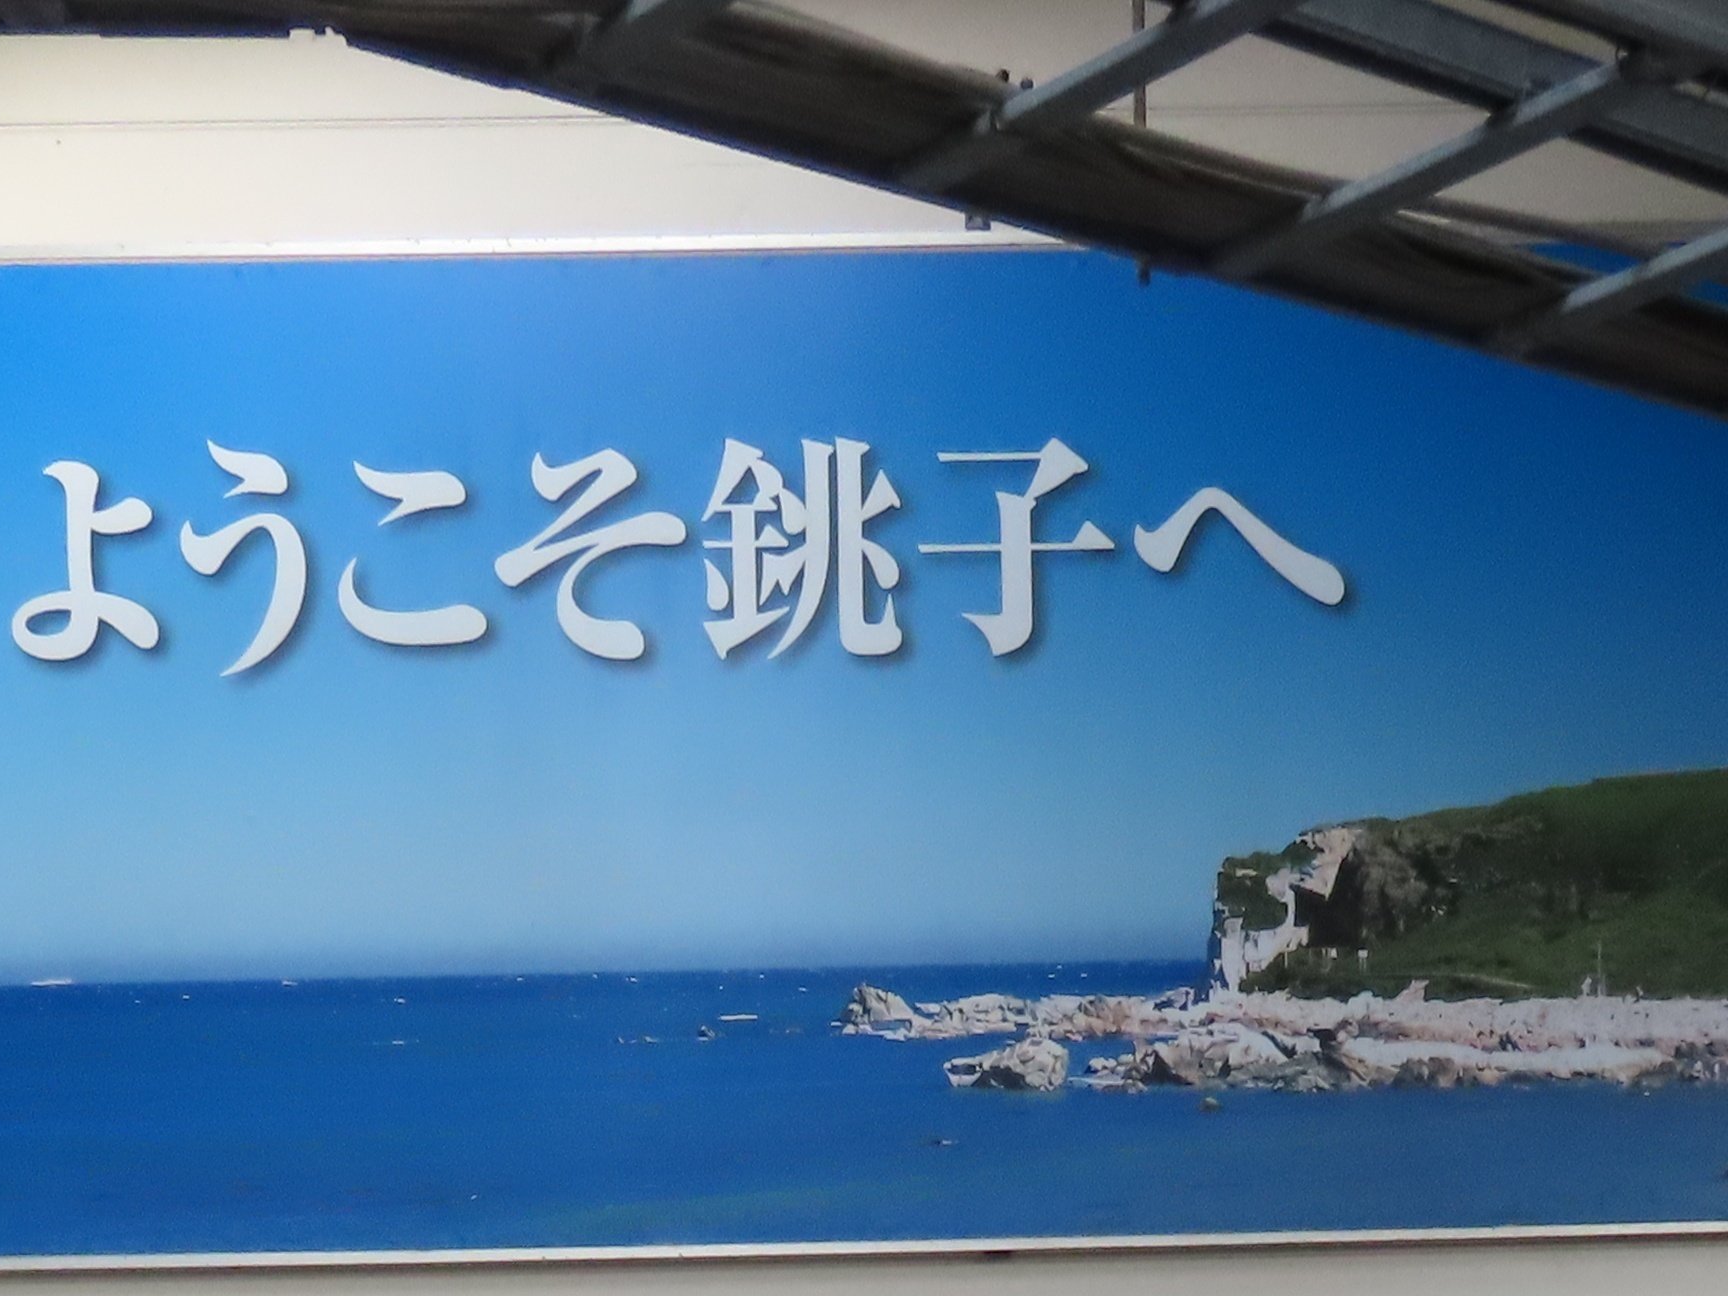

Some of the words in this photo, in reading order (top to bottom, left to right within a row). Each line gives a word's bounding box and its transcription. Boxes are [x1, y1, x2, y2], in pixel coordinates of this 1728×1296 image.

[12, 435, 1345, 676] ようこそ銚子へ
